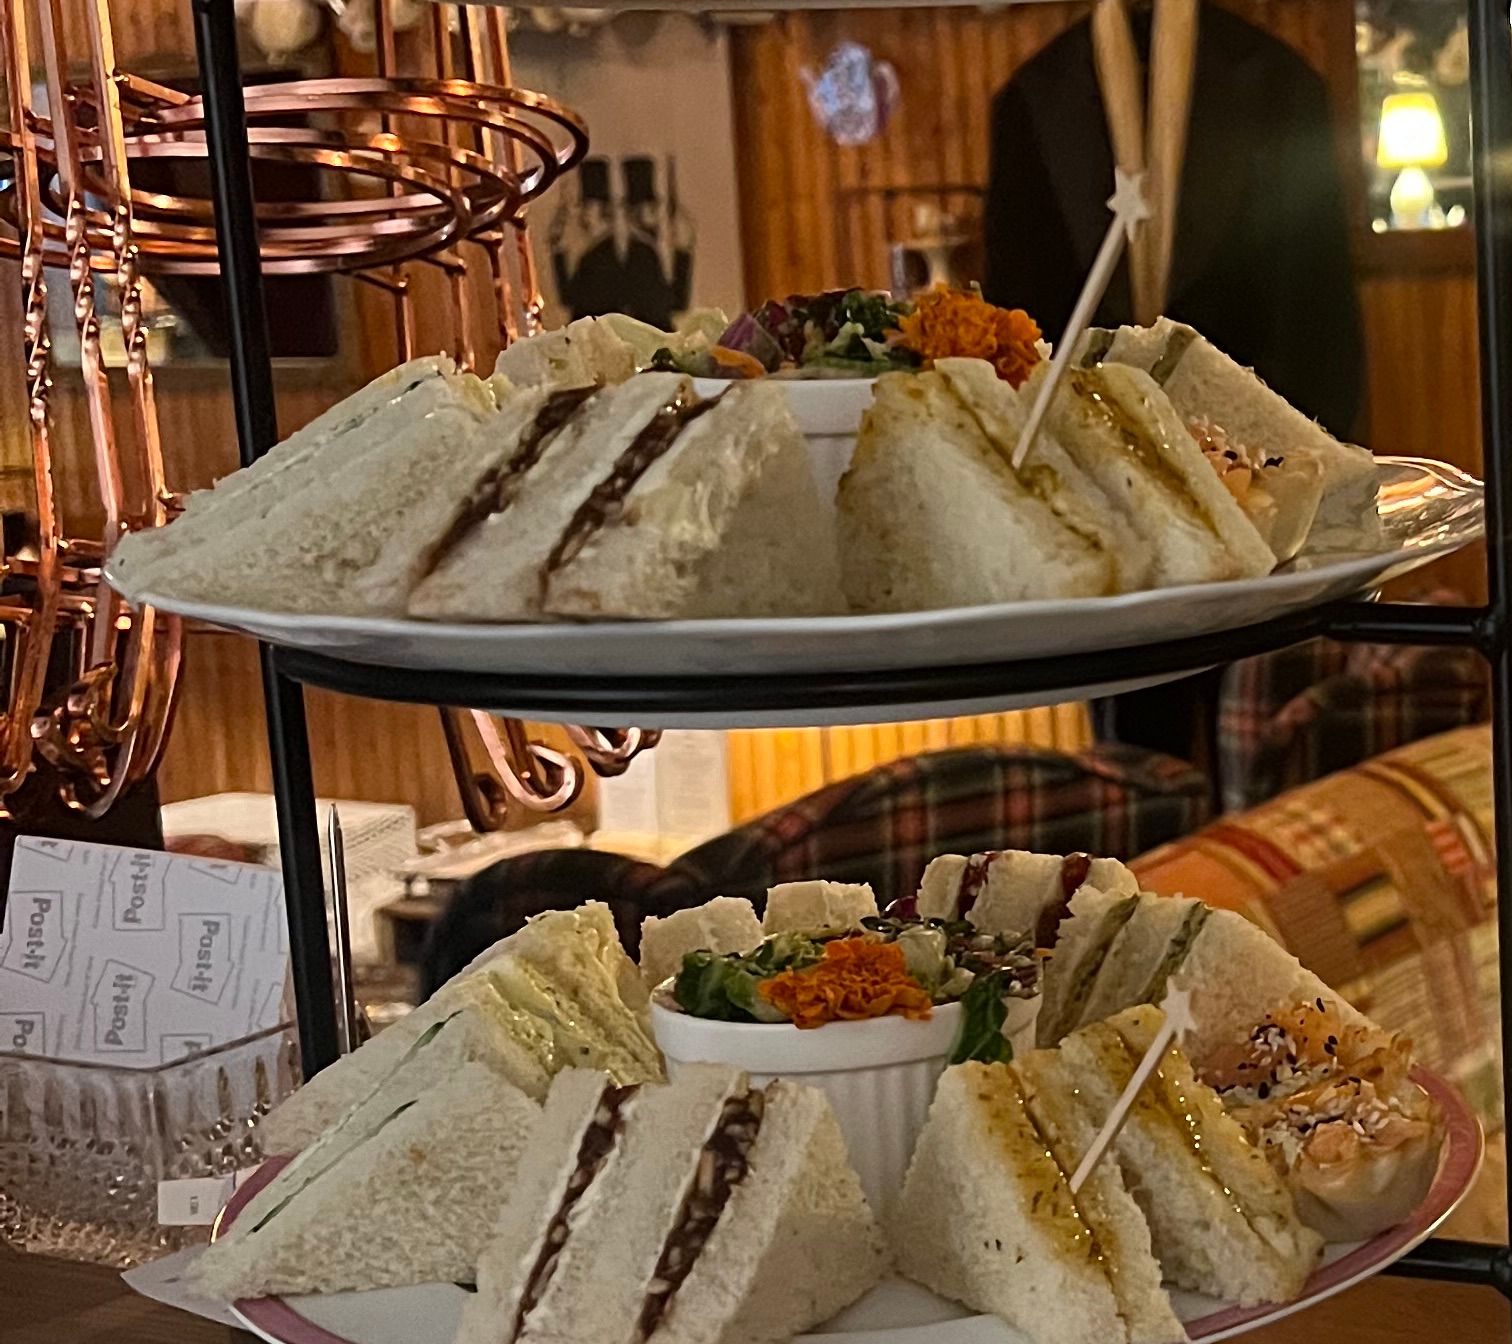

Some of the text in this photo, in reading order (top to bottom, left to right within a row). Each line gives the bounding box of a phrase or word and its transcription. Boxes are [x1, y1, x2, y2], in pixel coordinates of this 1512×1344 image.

[23, 897, 52, 970] Post-it
[186, 919, 221, 993] Post-it
[104, 973, 136, 1046] Post-it
